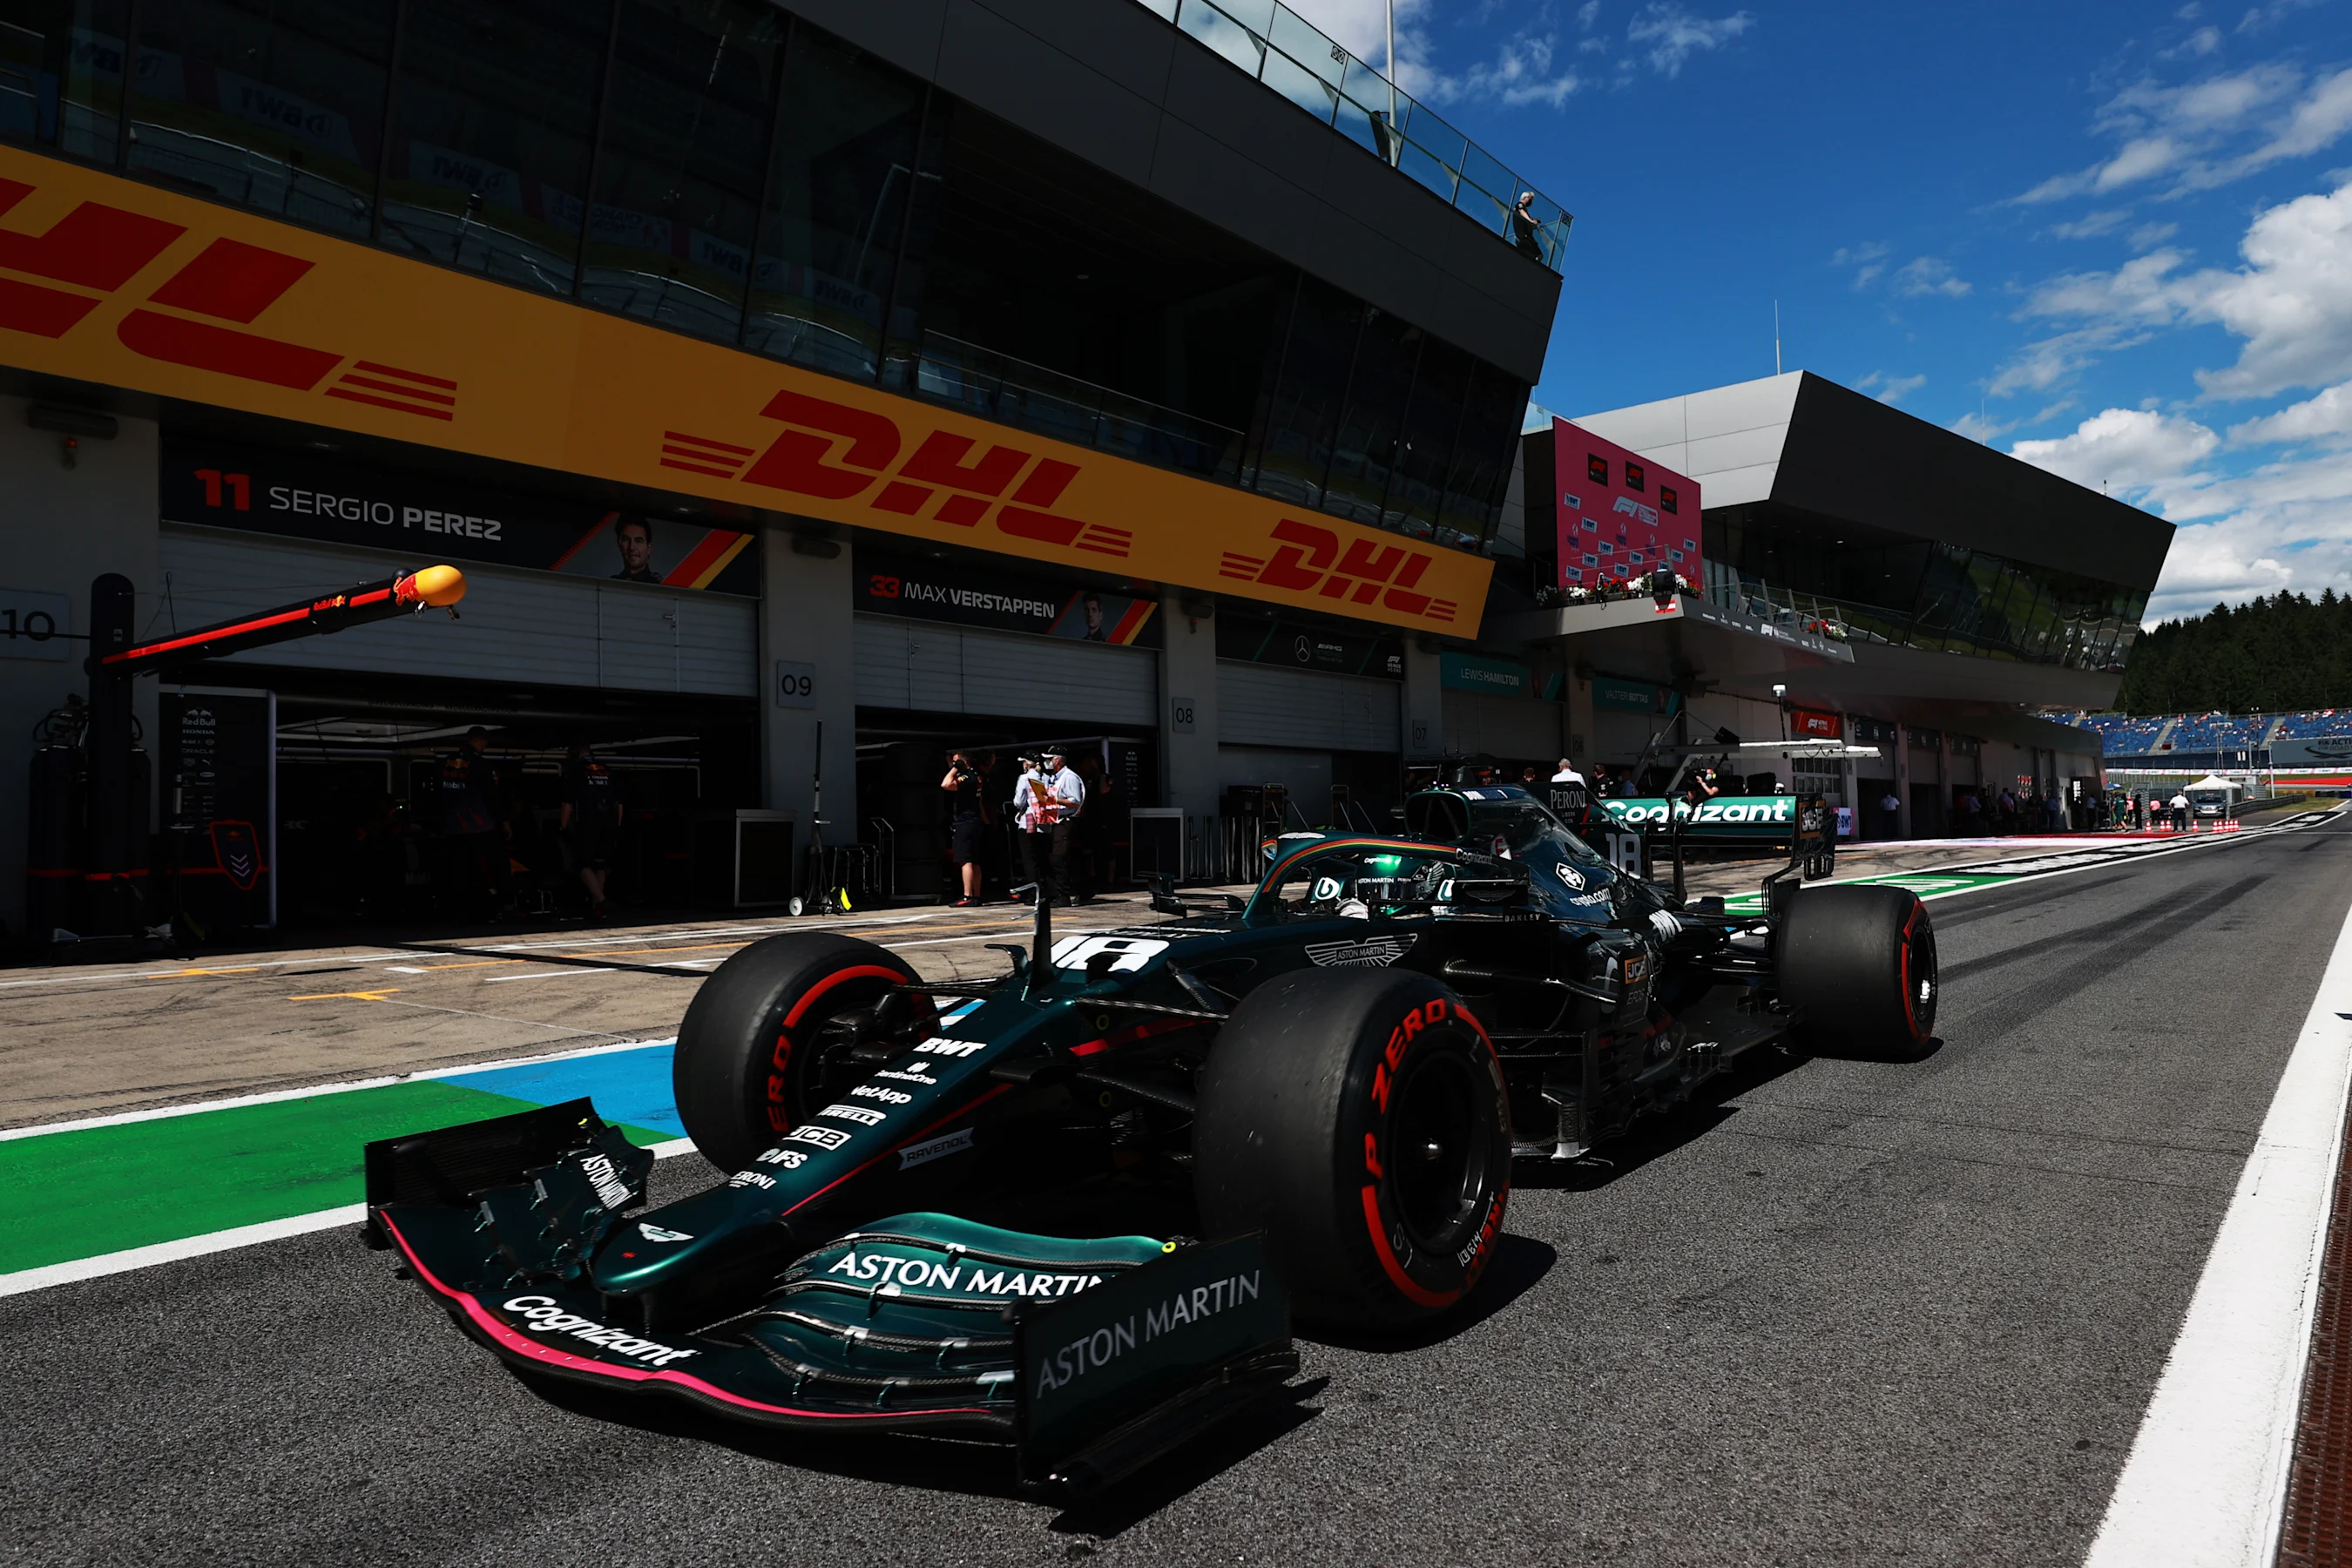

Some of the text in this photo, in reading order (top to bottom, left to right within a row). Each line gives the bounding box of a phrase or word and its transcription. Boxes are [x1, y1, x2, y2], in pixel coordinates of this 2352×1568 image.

[741, 389, 1087, 546] DHL
[193, 468, 502, 541] 11 SERGIO PEREZ
[1257, 518, 1432, 615] DHL
[869, 575, 1055, 618] 33 MAX VERSTAPPEN
[7, 611, 55, 641] 10
[781, 674, 812, 697] 09
[1460, 667, 1520, 686] LEWIS HAMILTON
[182, 717, 216, 727] Red Bull
[1176, 707, 1194, 725] 08
[1416, 727, 1427, 741] 07
[1575, 741, 1585, 753] 06
[1550, 789, 1586, 809] PERONI
[1456, 848, 1494, 865] Cognizant
[1605, 832, 1641, 880] 18
[1504, 913, 1541, 923] OAKLEY
[1051, 936, 1171, 973] 18
[1337, 944, 1387, 962] ASTON MARTIN
[913, 1037, 988, 1058] BWT
[1364, 997, 1447, 1179] P ZERO
[907, 1136, 968, 1162] RAVENOL
[578, 1152, 619, 1190] ASTON
[828, 1253, 962, 1289] ASTON
[502, 1295, 700, 1367] Cognizant
[1036, 1269, 1260, 1400] ASTON MARTIN
